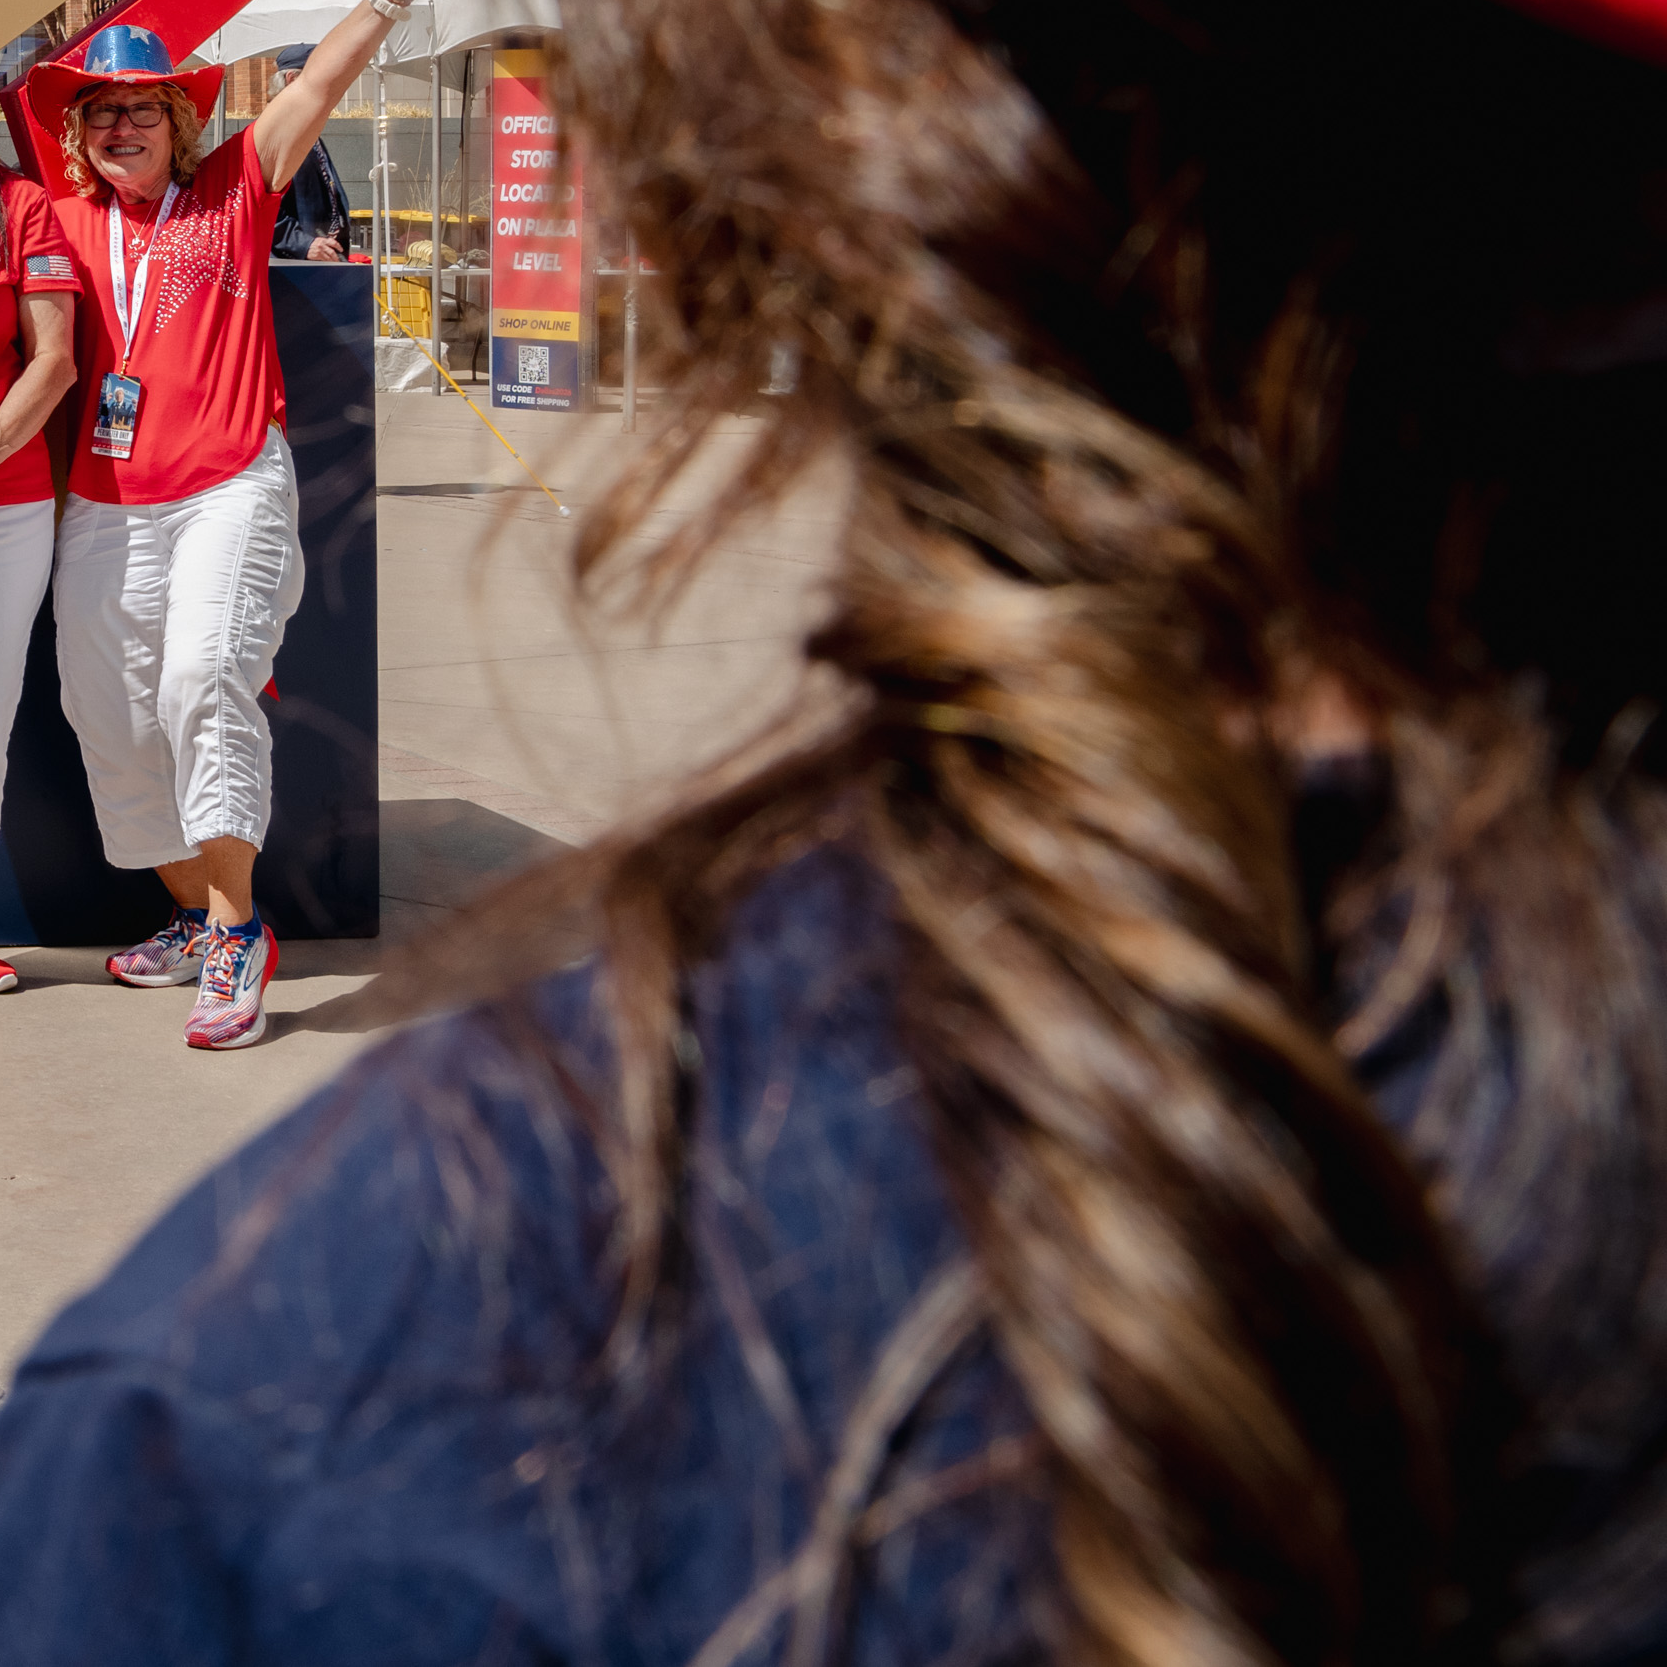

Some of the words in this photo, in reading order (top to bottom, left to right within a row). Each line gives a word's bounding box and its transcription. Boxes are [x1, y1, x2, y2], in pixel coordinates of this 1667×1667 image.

[501, 116, 559, 134] OFFICI
[510, 150, 560, 169] STOR
[497, 217, 521, 236] ON
[513, 251, 562, 271] LEVEL
[499, 317, 528, 329] SHOP
[530, 319, 571, 331] ONLINE
[497, 383, 511, 392] USE
[512, 385, 533, 394] CODE
[501, 394, 516, 403] FOR
[517, 395, 535, 405] FREE
[536, 397, 570, 407] SHIPPING
